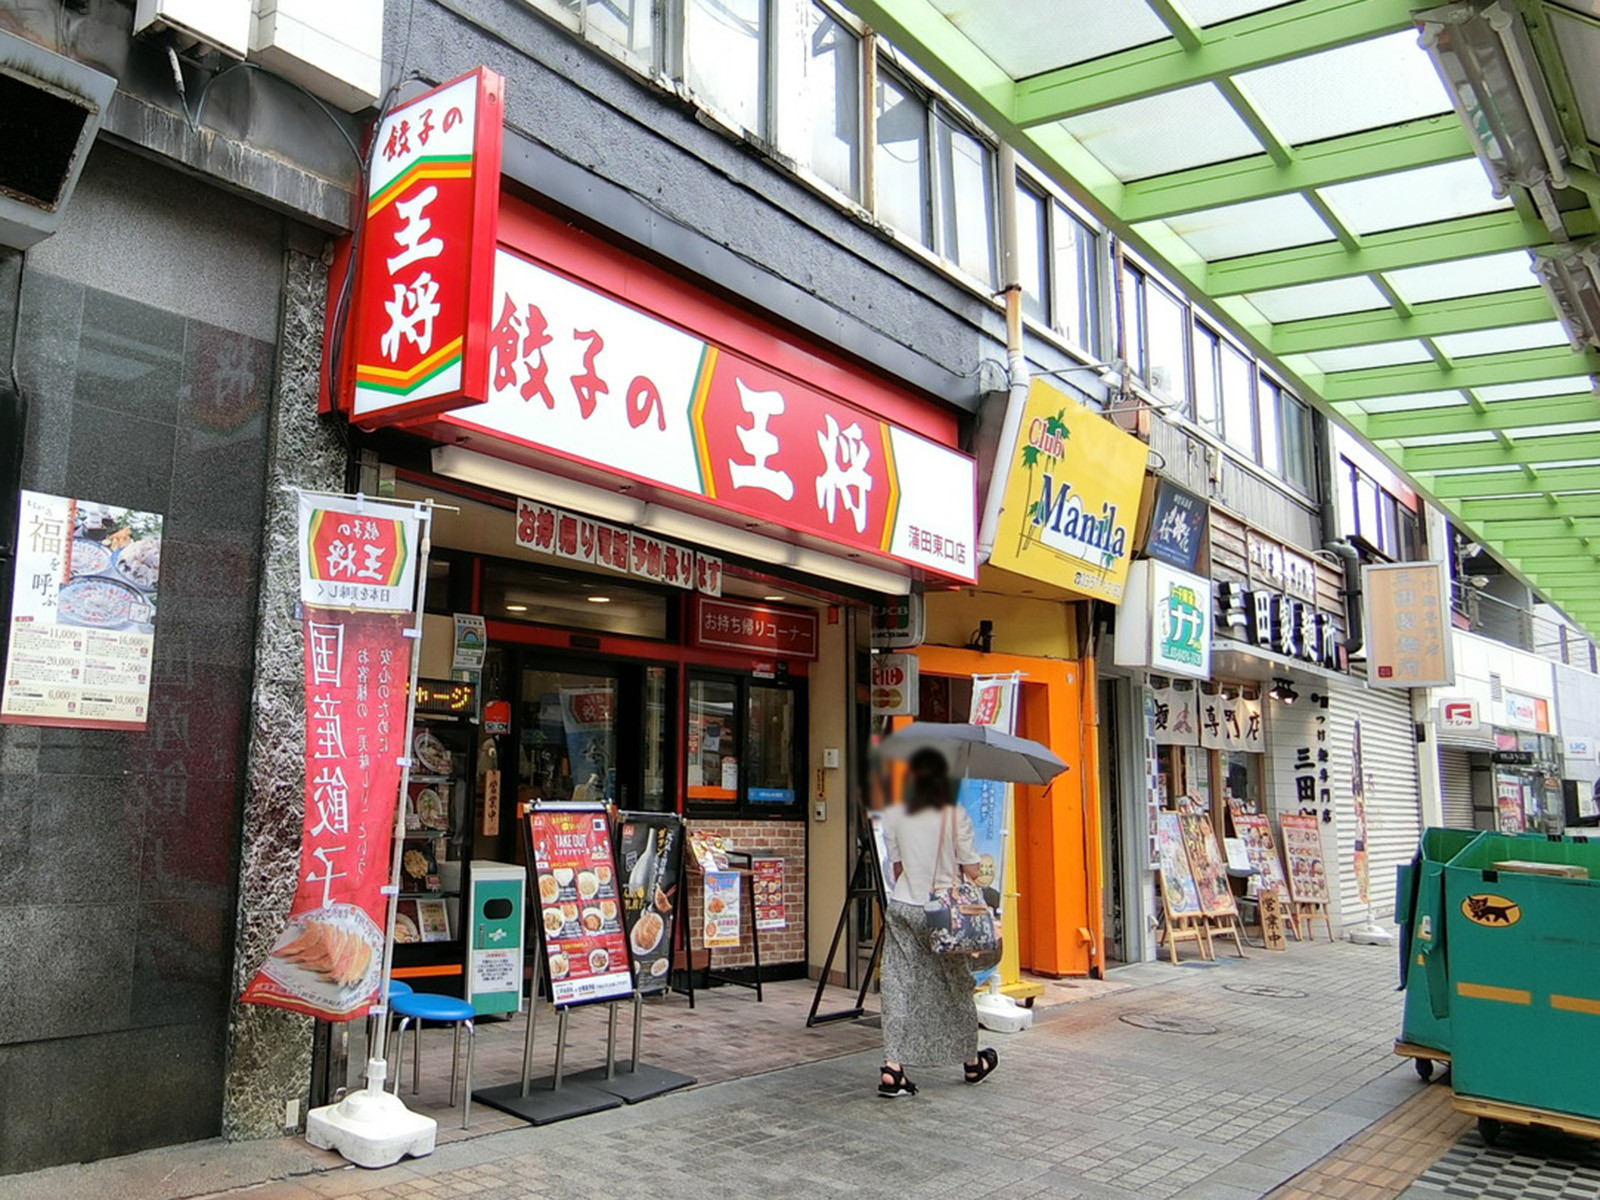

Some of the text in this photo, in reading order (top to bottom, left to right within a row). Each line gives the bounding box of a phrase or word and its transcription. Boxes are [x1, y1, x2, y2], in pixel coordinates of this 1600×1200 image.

[382, 106, 464, 162] 餃子の
[380, 185, 444, 363] 王将
[489, 291, 874, 534] 餃子の 王将
[1028, 417, 1064, 457] Club
[1032, 474, 1126, 557] Manila
[908, 524, 967, 566] 蒲田東口店
[704, 611, 811, 640] お持ち帰りコーナー
[1204, 705, 1260, 740] 専門店
[1261, 896, 1282, 948] 営業中
